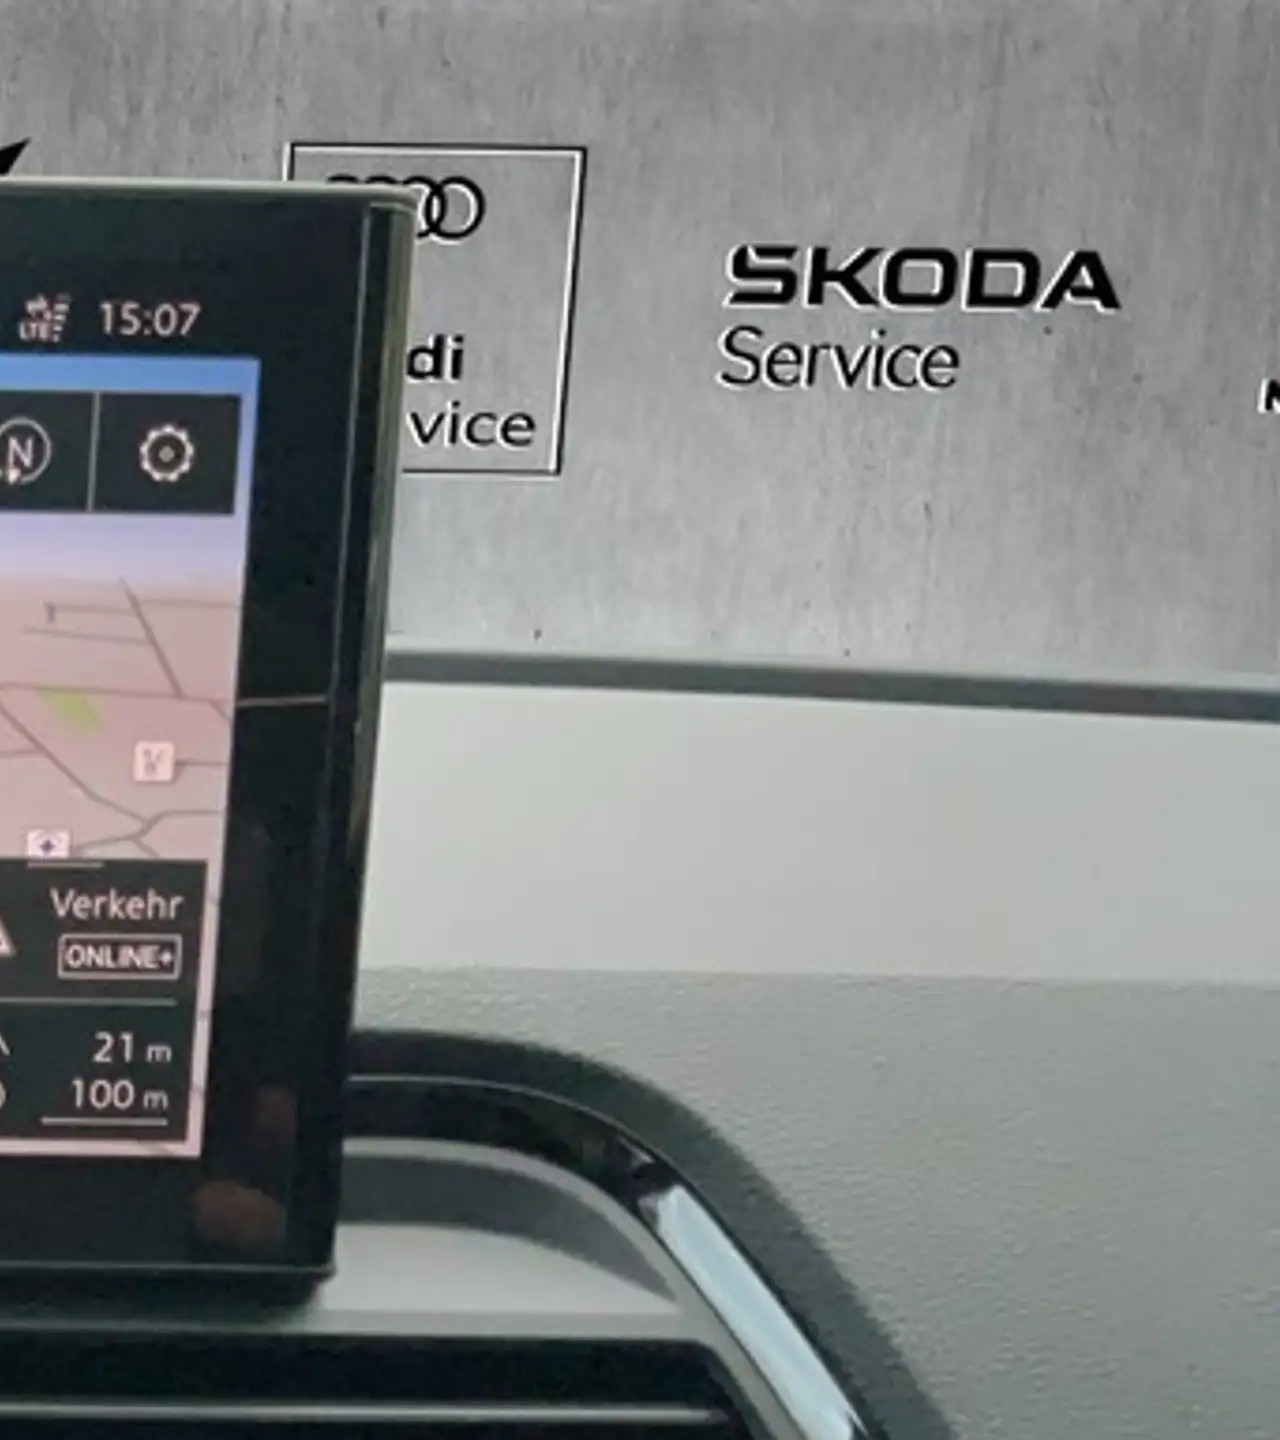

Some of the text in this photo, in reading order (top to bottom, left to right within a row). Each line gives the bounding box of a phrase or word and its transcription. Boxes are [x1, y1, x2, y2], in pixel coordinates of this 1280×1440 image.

[724, 244, 1122, 311] SKODA
[100, 300, 202, 338] 15:07
[406, 334, 465, 381] di
[716, 324, 960, 389] Service
[406, 400, 537, 448] vice
[49, 887, 185, 921] Verkehr
[65, 942, 174, 970] ONLINE+
[92, 1030, 173, 1064] 21 m
[71, 1075, 170, 1110] 100 m
